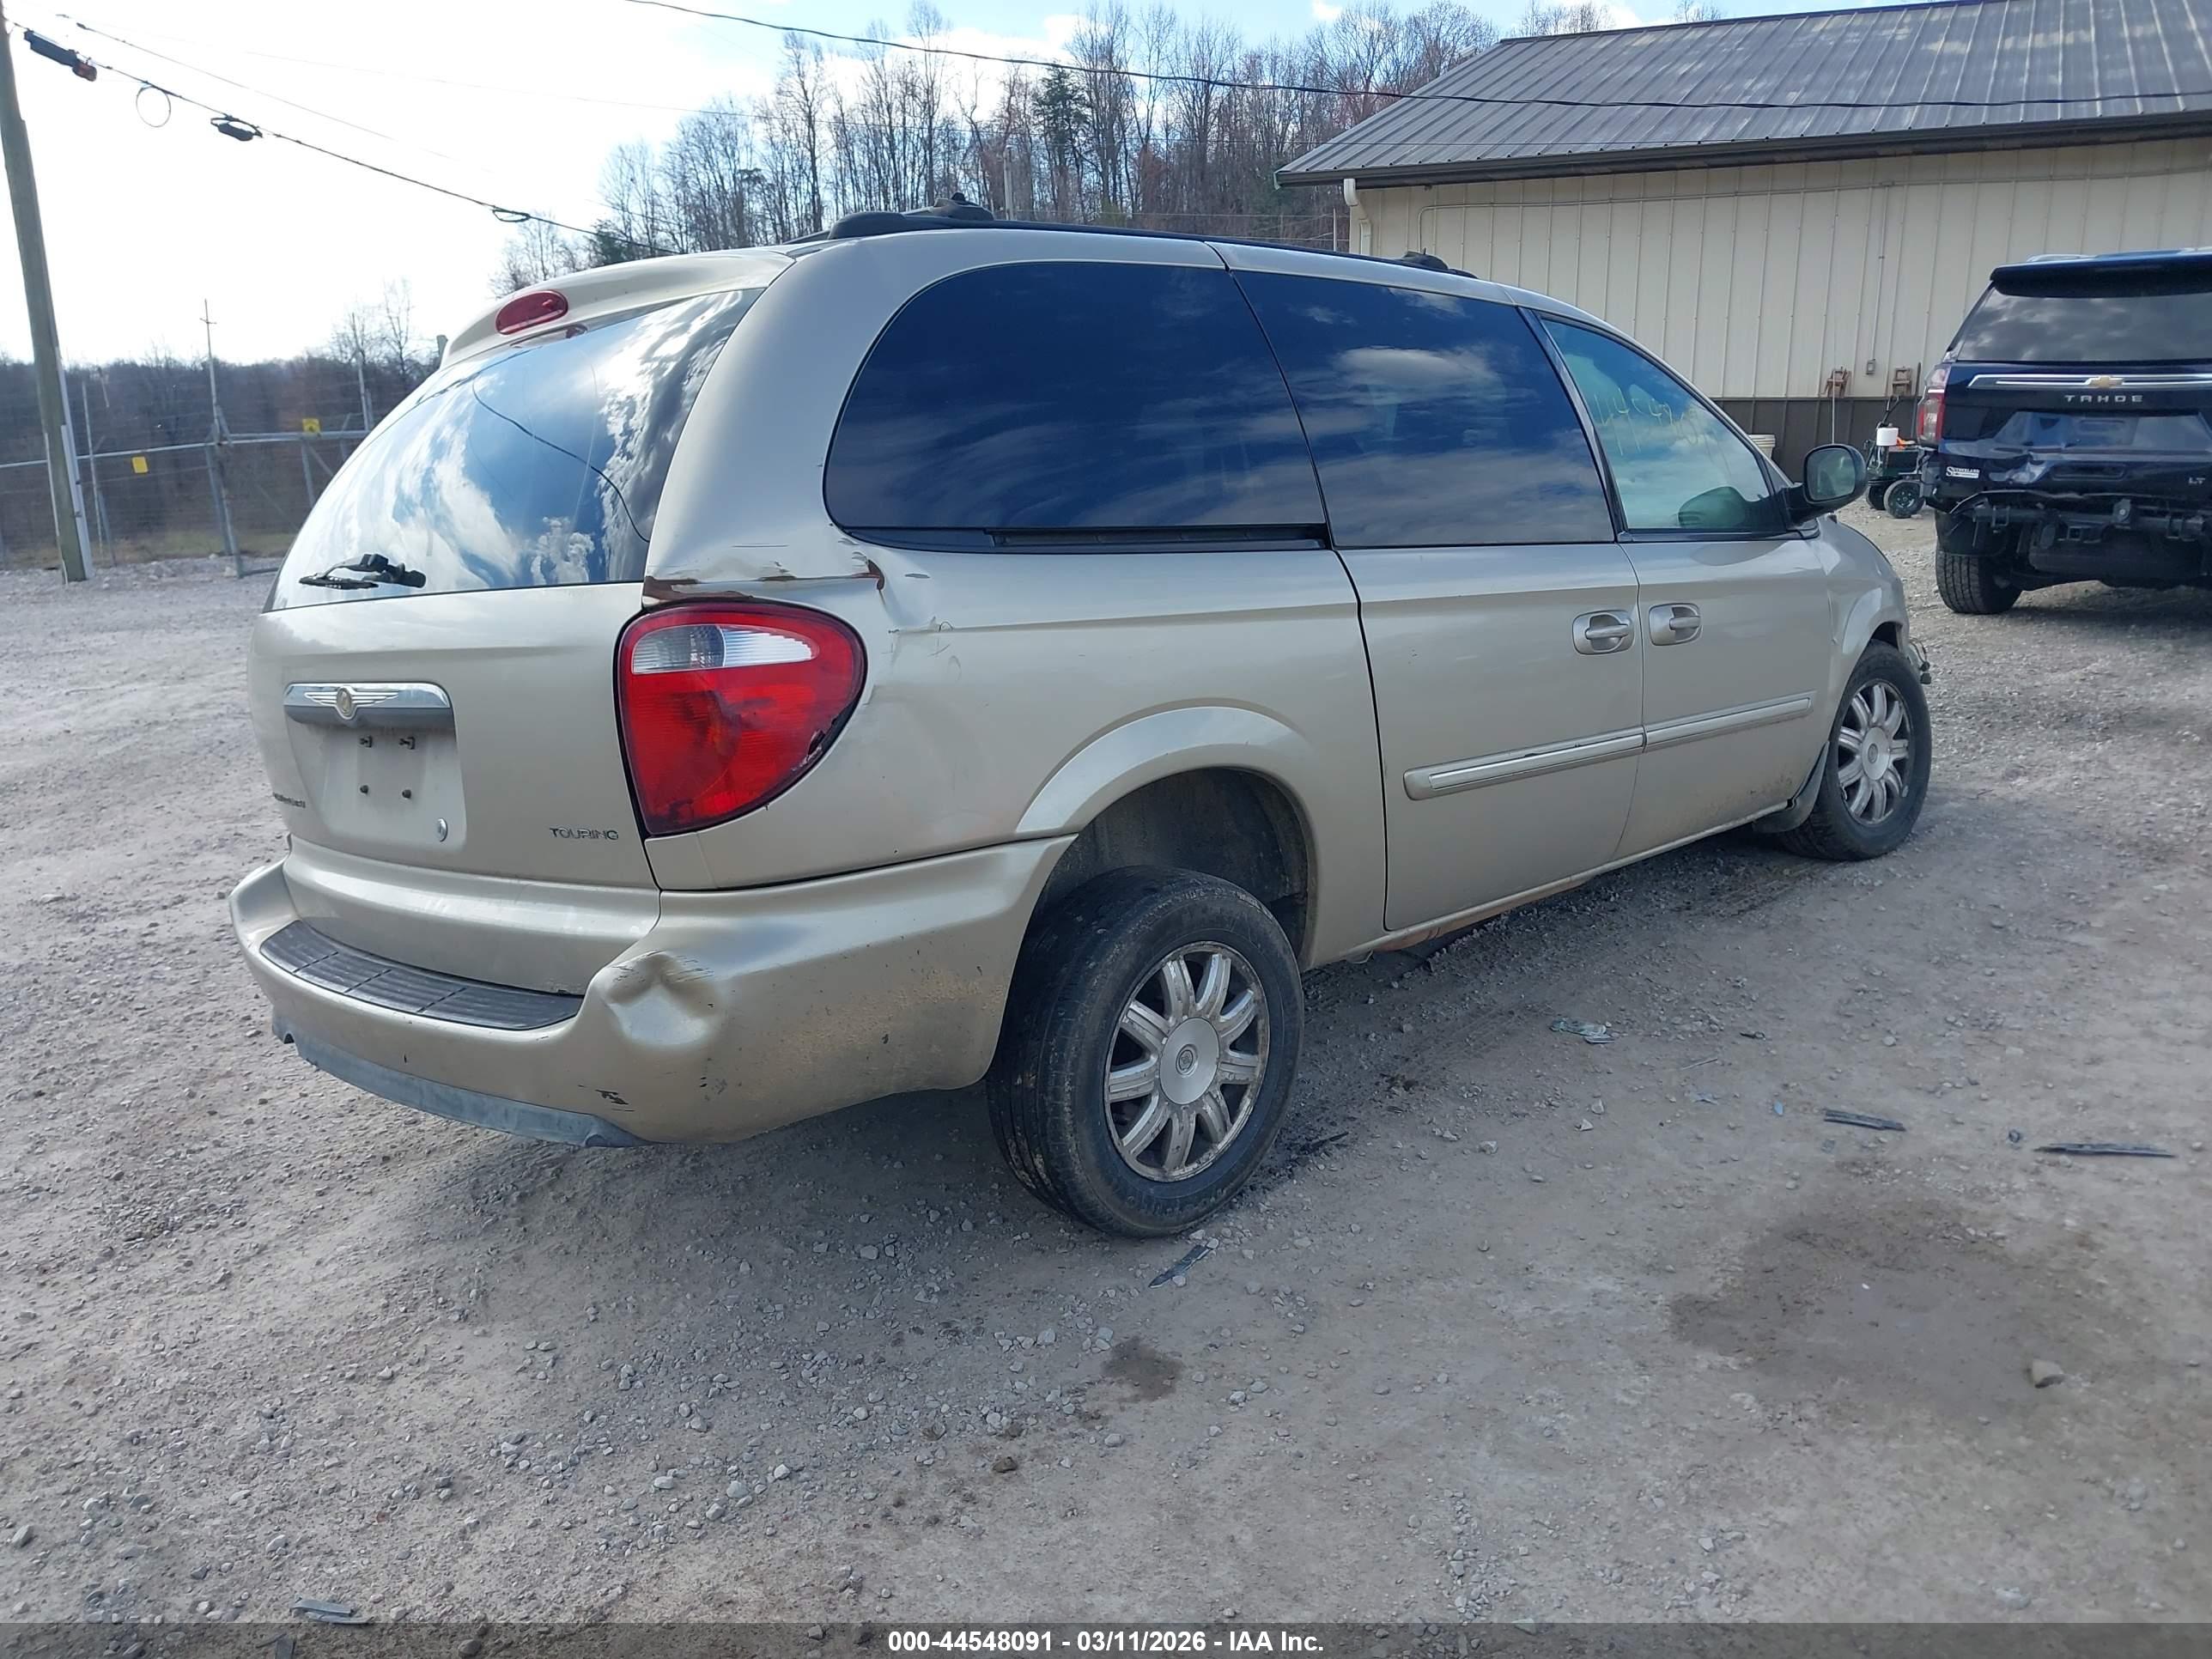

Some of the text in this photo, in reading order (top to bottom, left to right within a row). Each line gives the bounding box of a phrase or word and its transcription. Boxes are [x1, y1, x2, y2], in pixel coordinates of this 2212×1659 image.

[2063, 394, 2143, 403] TAHOE
[2189, 477, 2206, 485] LT
[550, 827, 619, 840] TOURING
